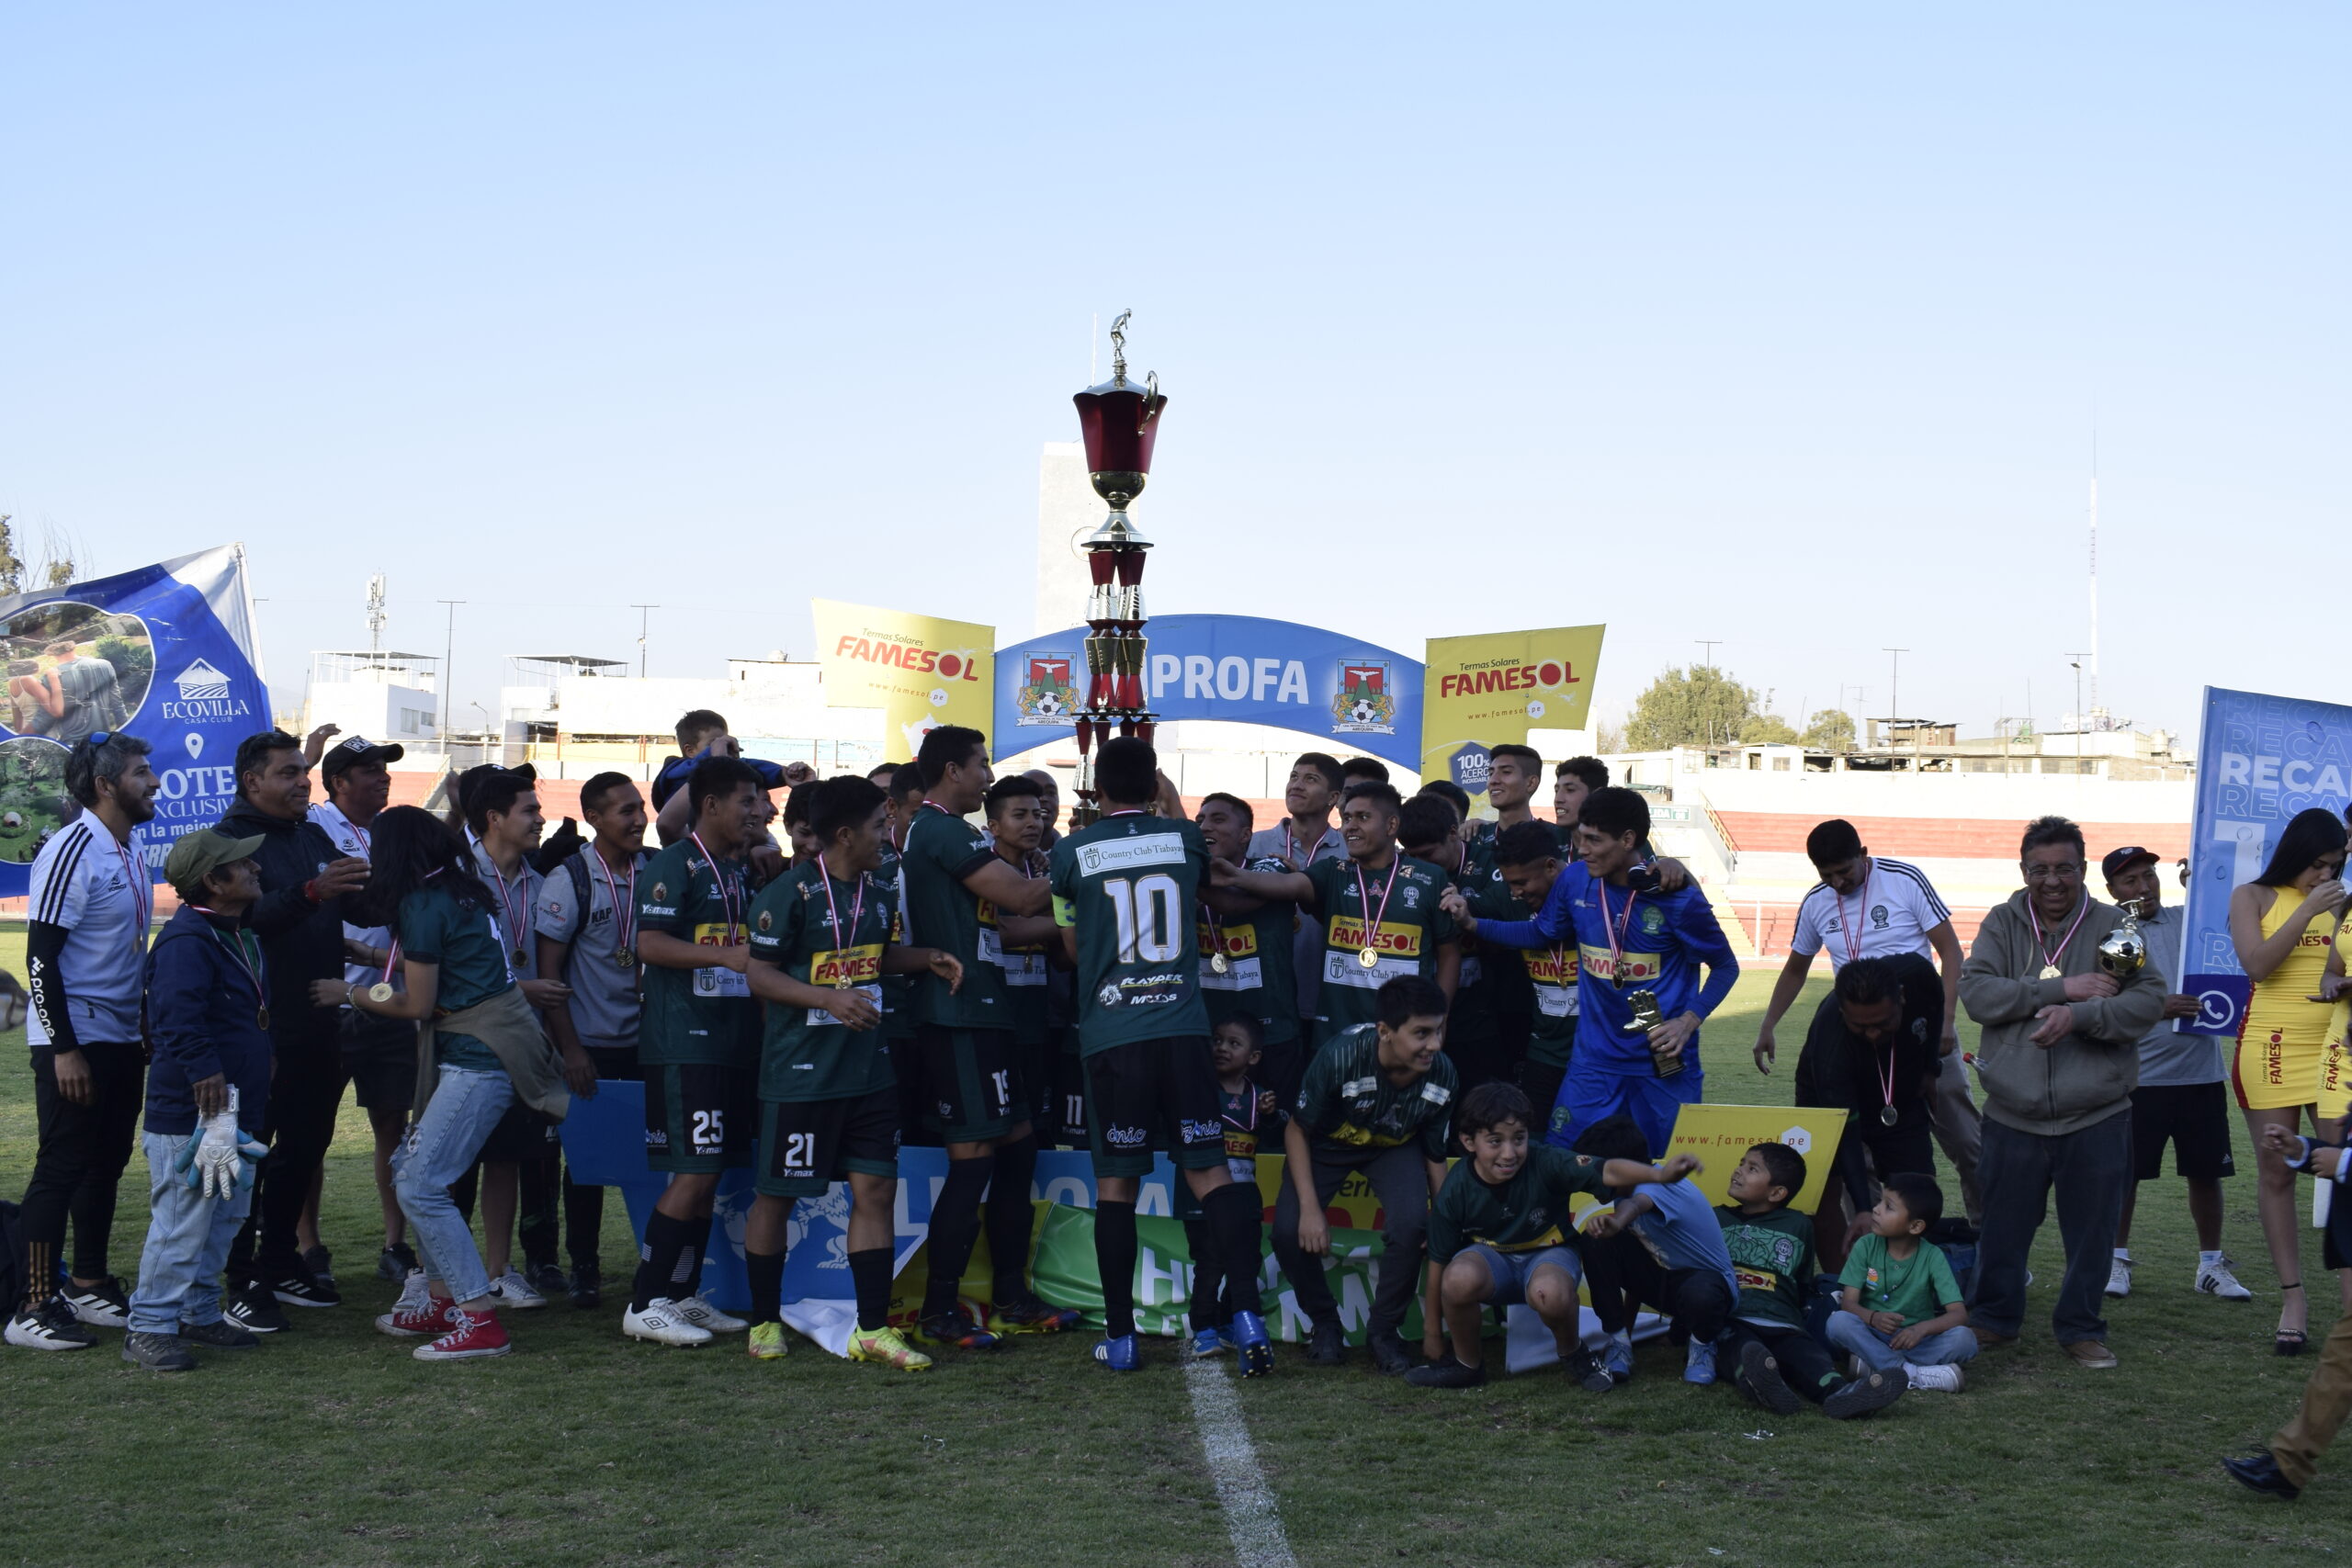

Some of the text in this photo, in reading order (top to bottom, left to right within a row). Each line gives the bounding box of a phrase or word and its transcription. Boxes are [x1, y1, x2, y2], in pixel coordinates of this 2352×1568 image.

[862, 628, 924, 647] Termas Solares
[836, 636, 978, 682] FAMESOL
[1461, 658, 1520, 671] Termas Solares
[1441, 661, 1580, 698] FAMESOL
[869, 682, 944, 700] www.famesol.pe
[162, 700, 250, 718] ECOVILLA
[1468, 706, 1541, 720] www.famesol.pe
[1457, 753, 1490, 770] 100%
[152, 765, 237, 800] OTE
[2220, 751, 2352, 797] RECA
[151, 823, 165, 838] la
[1101, 844, 1183, 860] Country Club Tiabaya
[592, 908, 612, 923] KAP
[1102, 873, 1182, 964] 10
[816, 956, 881, 981] FAMES
[1345, 964, 1369, 978] Country
[1371, 968, 1389, 979] Club
[2269, 1027, 2283, 1084] FAMESOL
[1066, 1095, 1082, 1125] 11
[693, 1110, 724, 1145] 25
[785, 1133, 815, 1167] 21
[783, 1168, 816, 1178] Yomax
